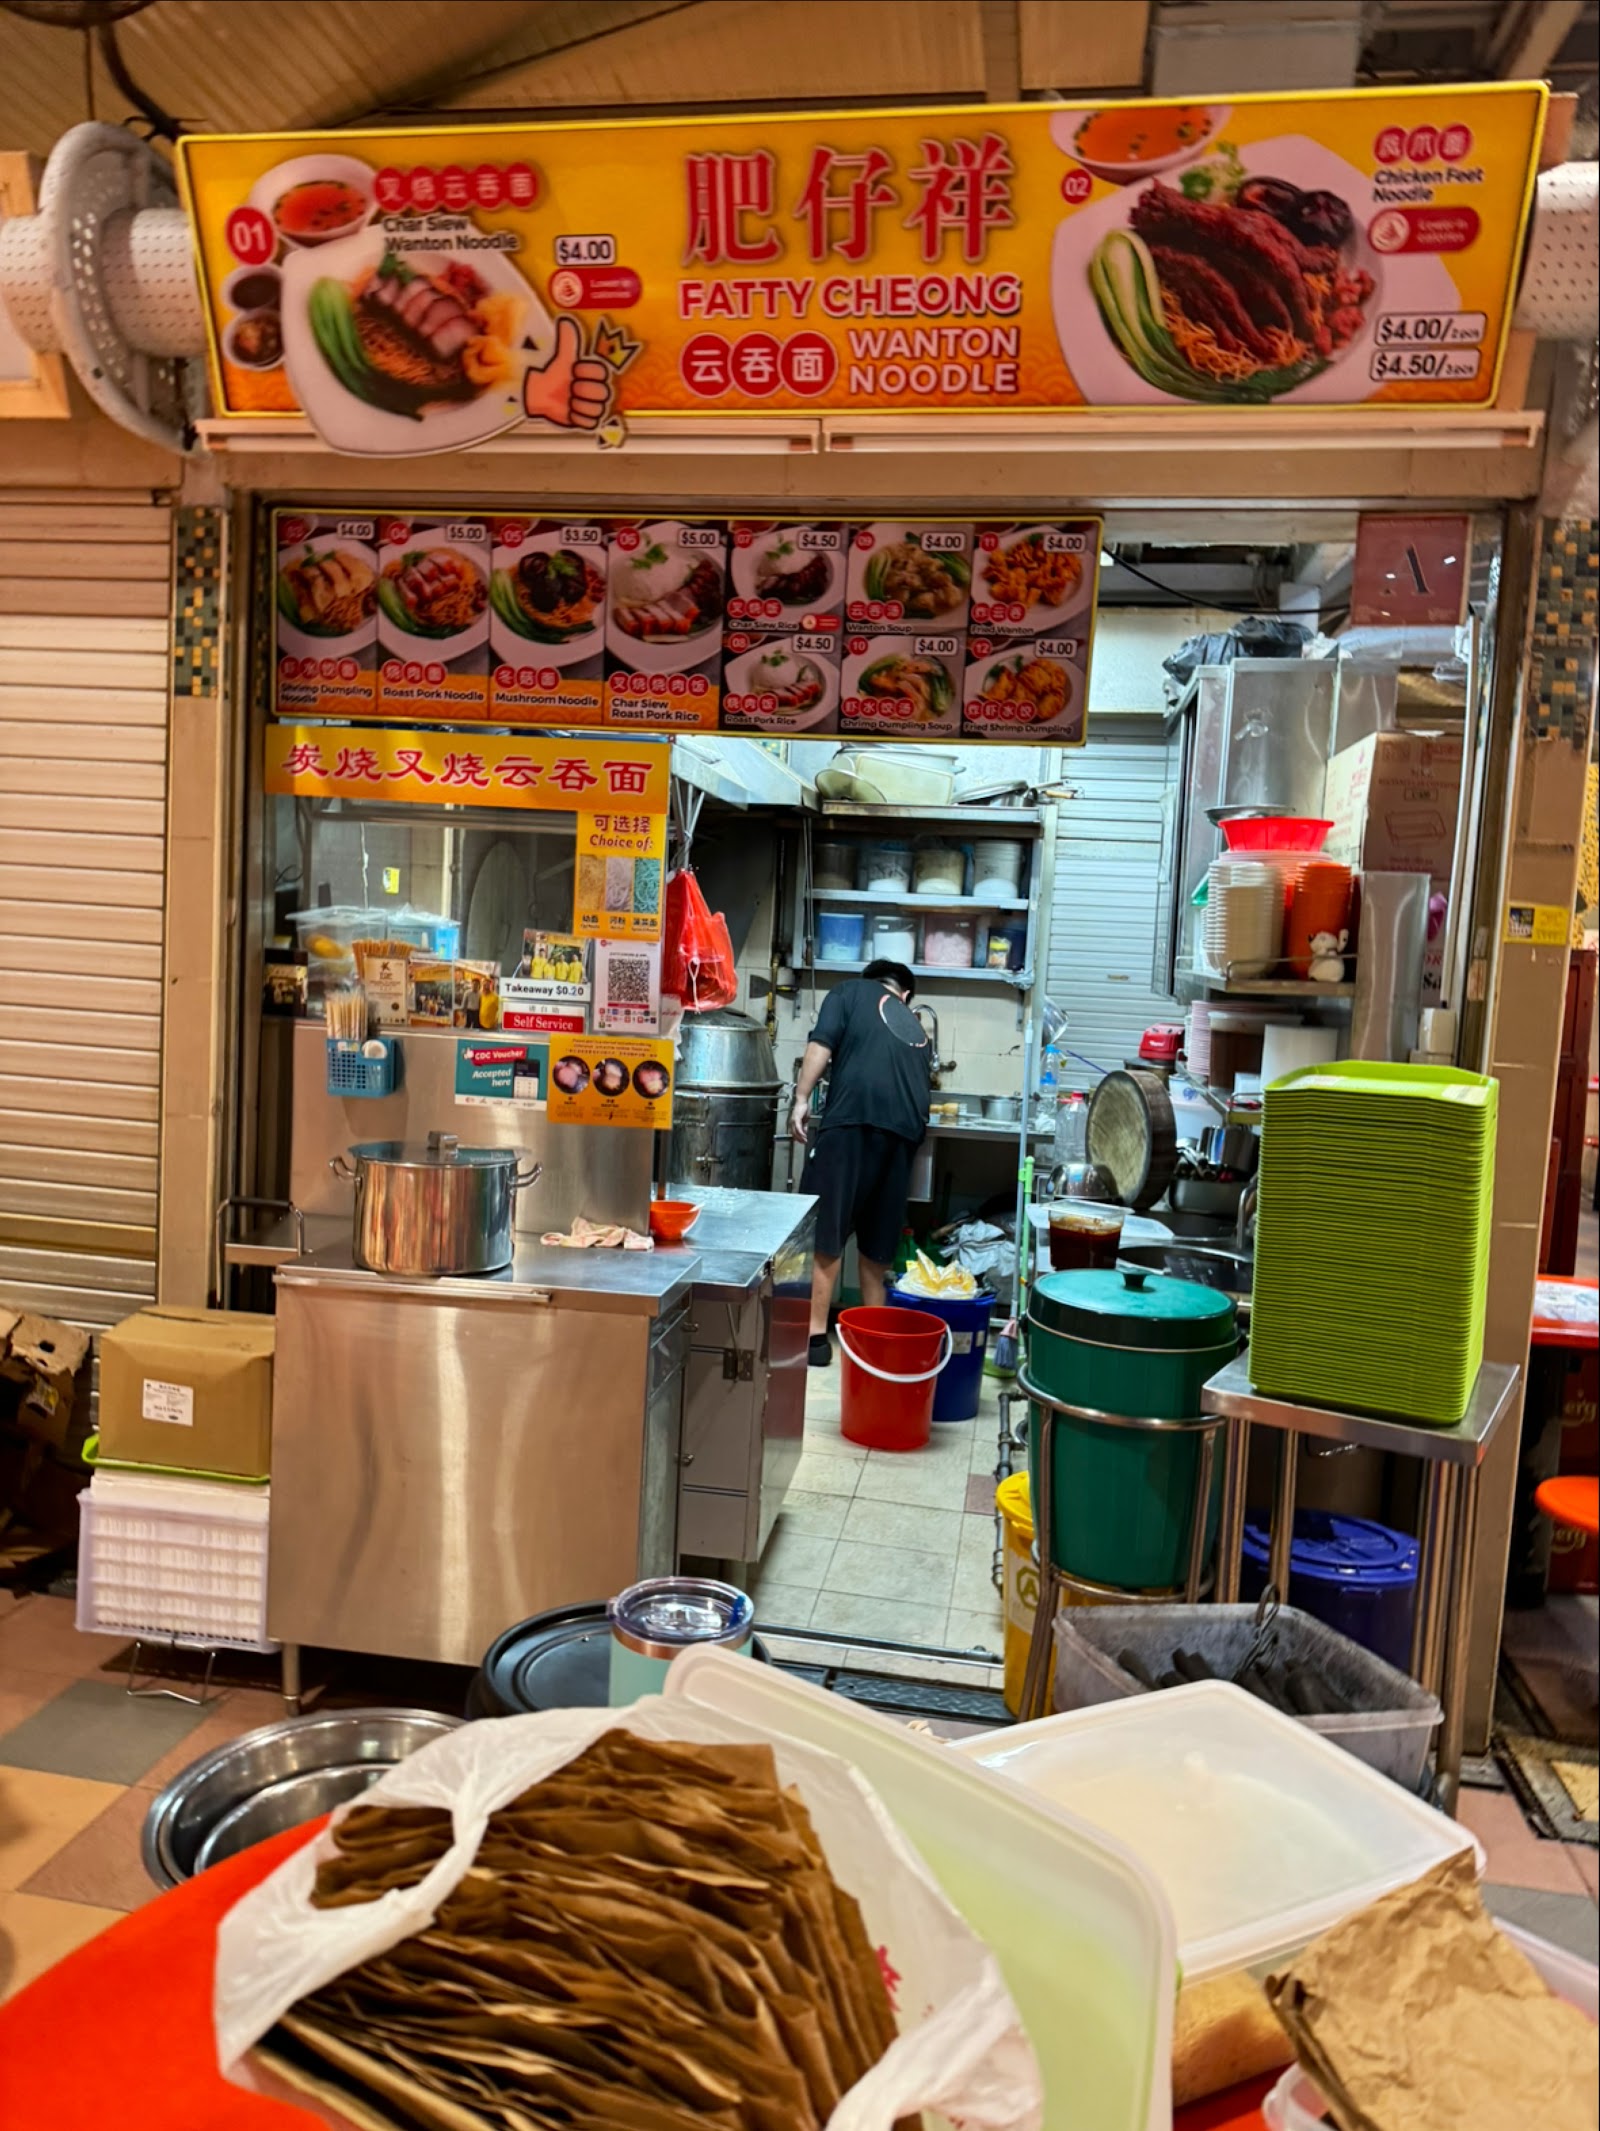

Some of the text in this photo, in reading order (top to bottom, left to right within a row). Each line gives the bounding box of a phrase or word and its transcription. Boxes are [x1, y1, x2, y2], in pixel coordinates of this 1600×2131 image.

[1375, 167, 1484, 185] Chicken Feet
[378, 172, 534, 202] 叉烧云吞面
[1065, 176, 1089, 197] 02
[681, 133, 1015, 266] 肥仔祥
[1373, 186, 1434, 202] Noodle
[383, 216, 468, 232] Char Siew
[232, 219, 267, 252] 01
[385, 233, 518, 251] Wanton Noodle
[559, 240, 612, 262] $4.00
[679, 274, 1022, 320] FATTY CHEONG
[847, 326, 1020, 359] WANTON
[689, 346, 825, 384] 云吞面
[848, 363, 1019, 395] NOODLE
[339, 523, 371, 536] $4.00
[390, 528, 408, 540] 04
[450, 526, 483, 540] $5.00
[504, 530, 522, 542] 05
[564, 530, 598, 543] $3.50
[681, 532, 716, 545] $5.00
[802, 535, 837, 547] $4.50
[925, 535, 961, 549] $4.00
[1047, 536, 1082, 550] $4.00
[778, 620, 798, 630] Rice
[848, 623, 886, 632] Wanton
[887, 624, 912, 634] Soup
[796, 638, 831, 650] $4.50
[852, 641, 866, 651] 10
[918, 640, 954, 653] $4.00
[1038, 641, 1074, 655] $4.00
[320, 685, 373, 697] Dumpling
[383, 687, 485, 701] Roast Pork Noodle
[495, 692, 599, 706] Mushroom Noodle
[611, 697, 669, 709] Char Siew
[611, 709, 700, 722] Roast Pork Rice
[726, 716, 797, 726] Roast Pork Rice
[843, 719, 953, 732] Shrimp Dumpling Soup
[281, 743, 654, 794] 炭烧叉烧云吞面
[593, 814, 651, 834] 可选择
[589, 833, 654, 852] Choice of:
[505, 983, 584, 997] Takeaway $0.20
[513, 1015, 574, 1031] Self Service
[474, 1049, 524, 1060] CDC Voucher
[472, 1068, 512, 1079] Accepted
[491, 1079, 511, 1088] here
